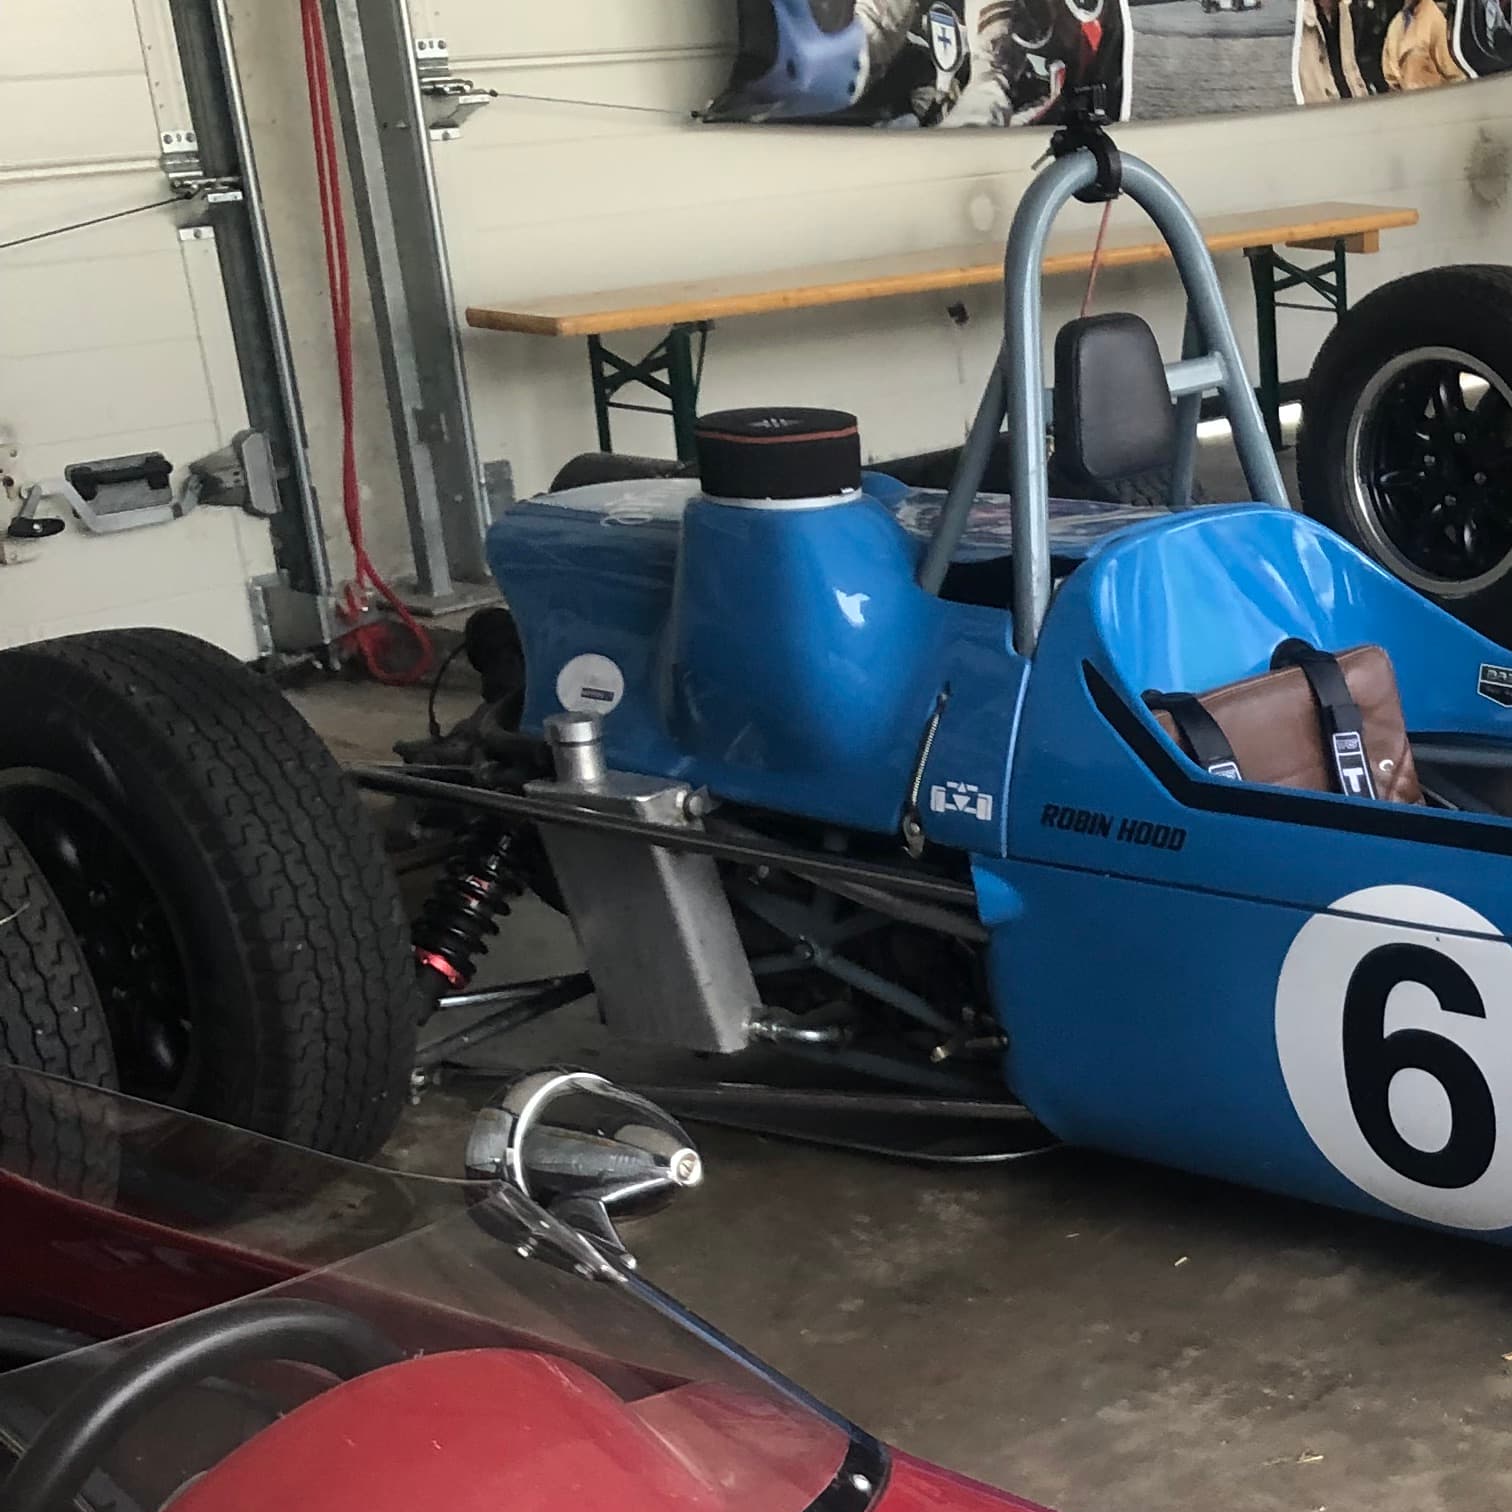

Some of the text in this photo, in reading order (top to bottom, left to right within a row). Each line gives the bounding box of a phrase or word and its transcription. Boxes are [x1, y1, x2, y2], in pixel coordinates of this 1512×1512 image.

[1040, 803, 1187, 852] ROBIN HOOD
[1341, 941, 1498, 1190] 6
